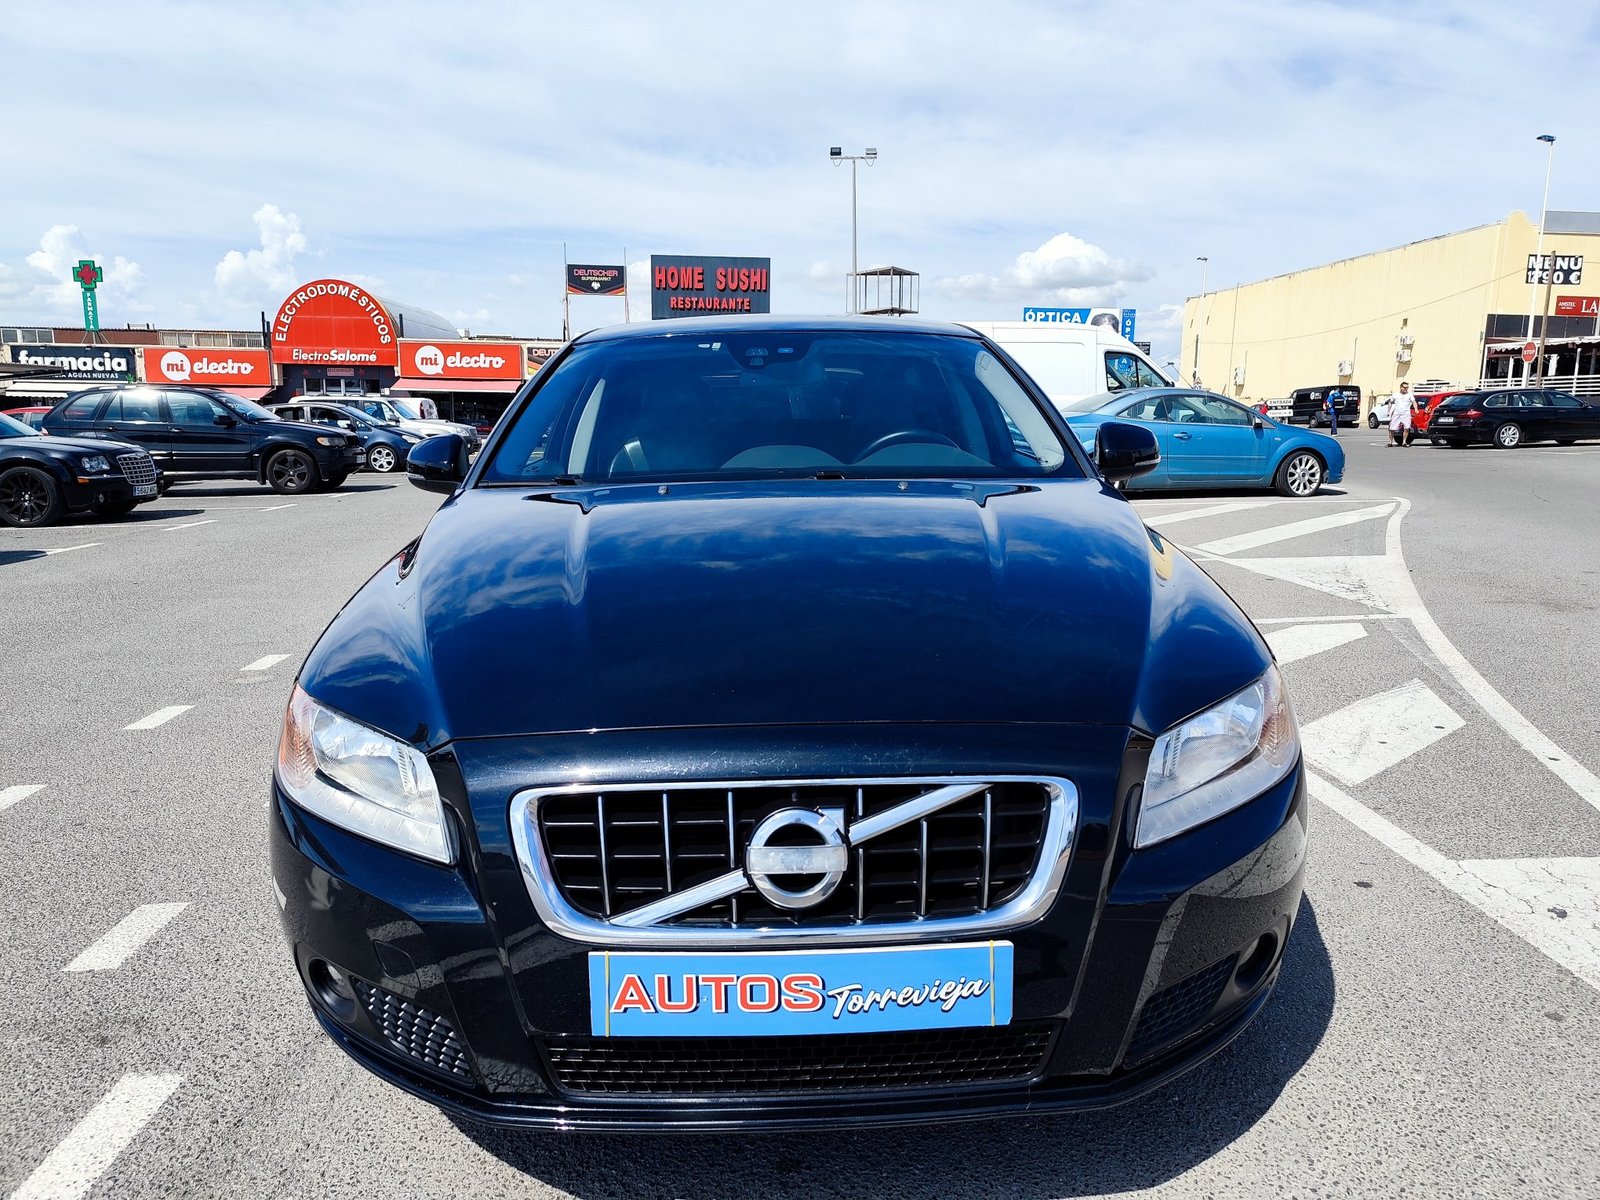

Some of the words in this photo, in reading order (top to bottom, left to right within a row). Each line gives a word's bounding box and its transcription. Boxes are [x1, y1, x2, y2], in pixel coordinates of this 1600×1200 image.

[1528, 255, 1583, 270] MENÚ
[573, 268, 619, 277] DEUTSCHER
[655, 265, 705, 291] HOME
[716, 267, 768, 292] SUSHI
[86, 292, 95, 330] FARMACIA
[670, 296, 751, 312] RESTAURANTE
[275, 283, 391, 344] ELECTRODOMÉSTICOS
[1024, 309, 1082, 323] ÓPTICA
[18, 350, 128, 371] farmacia
[292, 348, 378, 362] ElectroSalomé
[420, 353, 440, 367] mi
[446, 352, 505, 368] electro
[166, 358, 186, 373] mi
[193, 357, 254, 374] electro
[610, 973, 825, 1014] AUTOS
[827, 976, 991, 1018] Torrevieja
